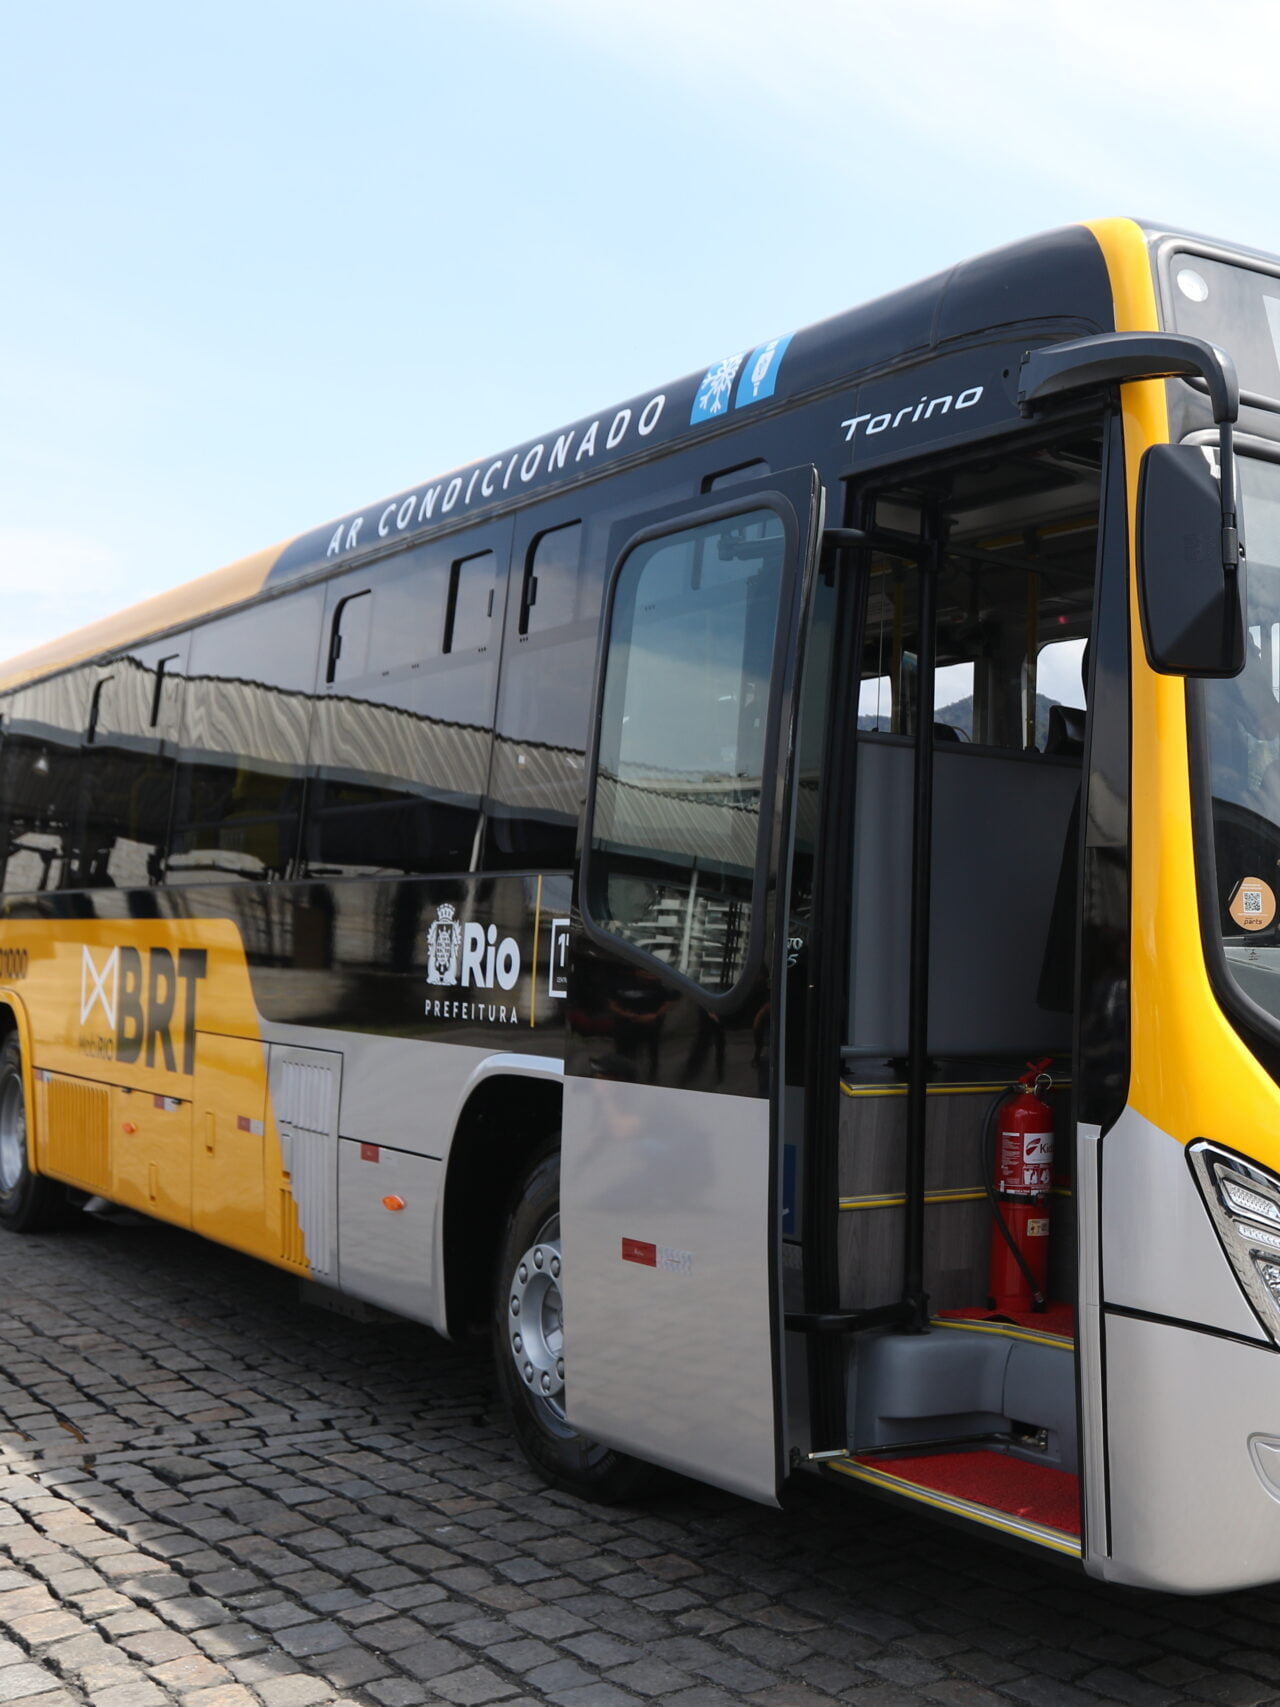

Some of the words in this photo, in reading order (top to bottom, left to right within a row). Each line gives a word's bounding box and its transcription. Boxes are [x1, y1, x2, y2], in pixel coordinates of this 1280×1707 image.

[840, 386, 984, 442] Torino
[327, 516, 364, 557] AR
[378, 394, 666, 538] CONDICIONADO
[461, 922, 521, 991] Rio
[115, 946, 208, 1076] BRT
[424, 999, 518, 1024] PREFEITURA
